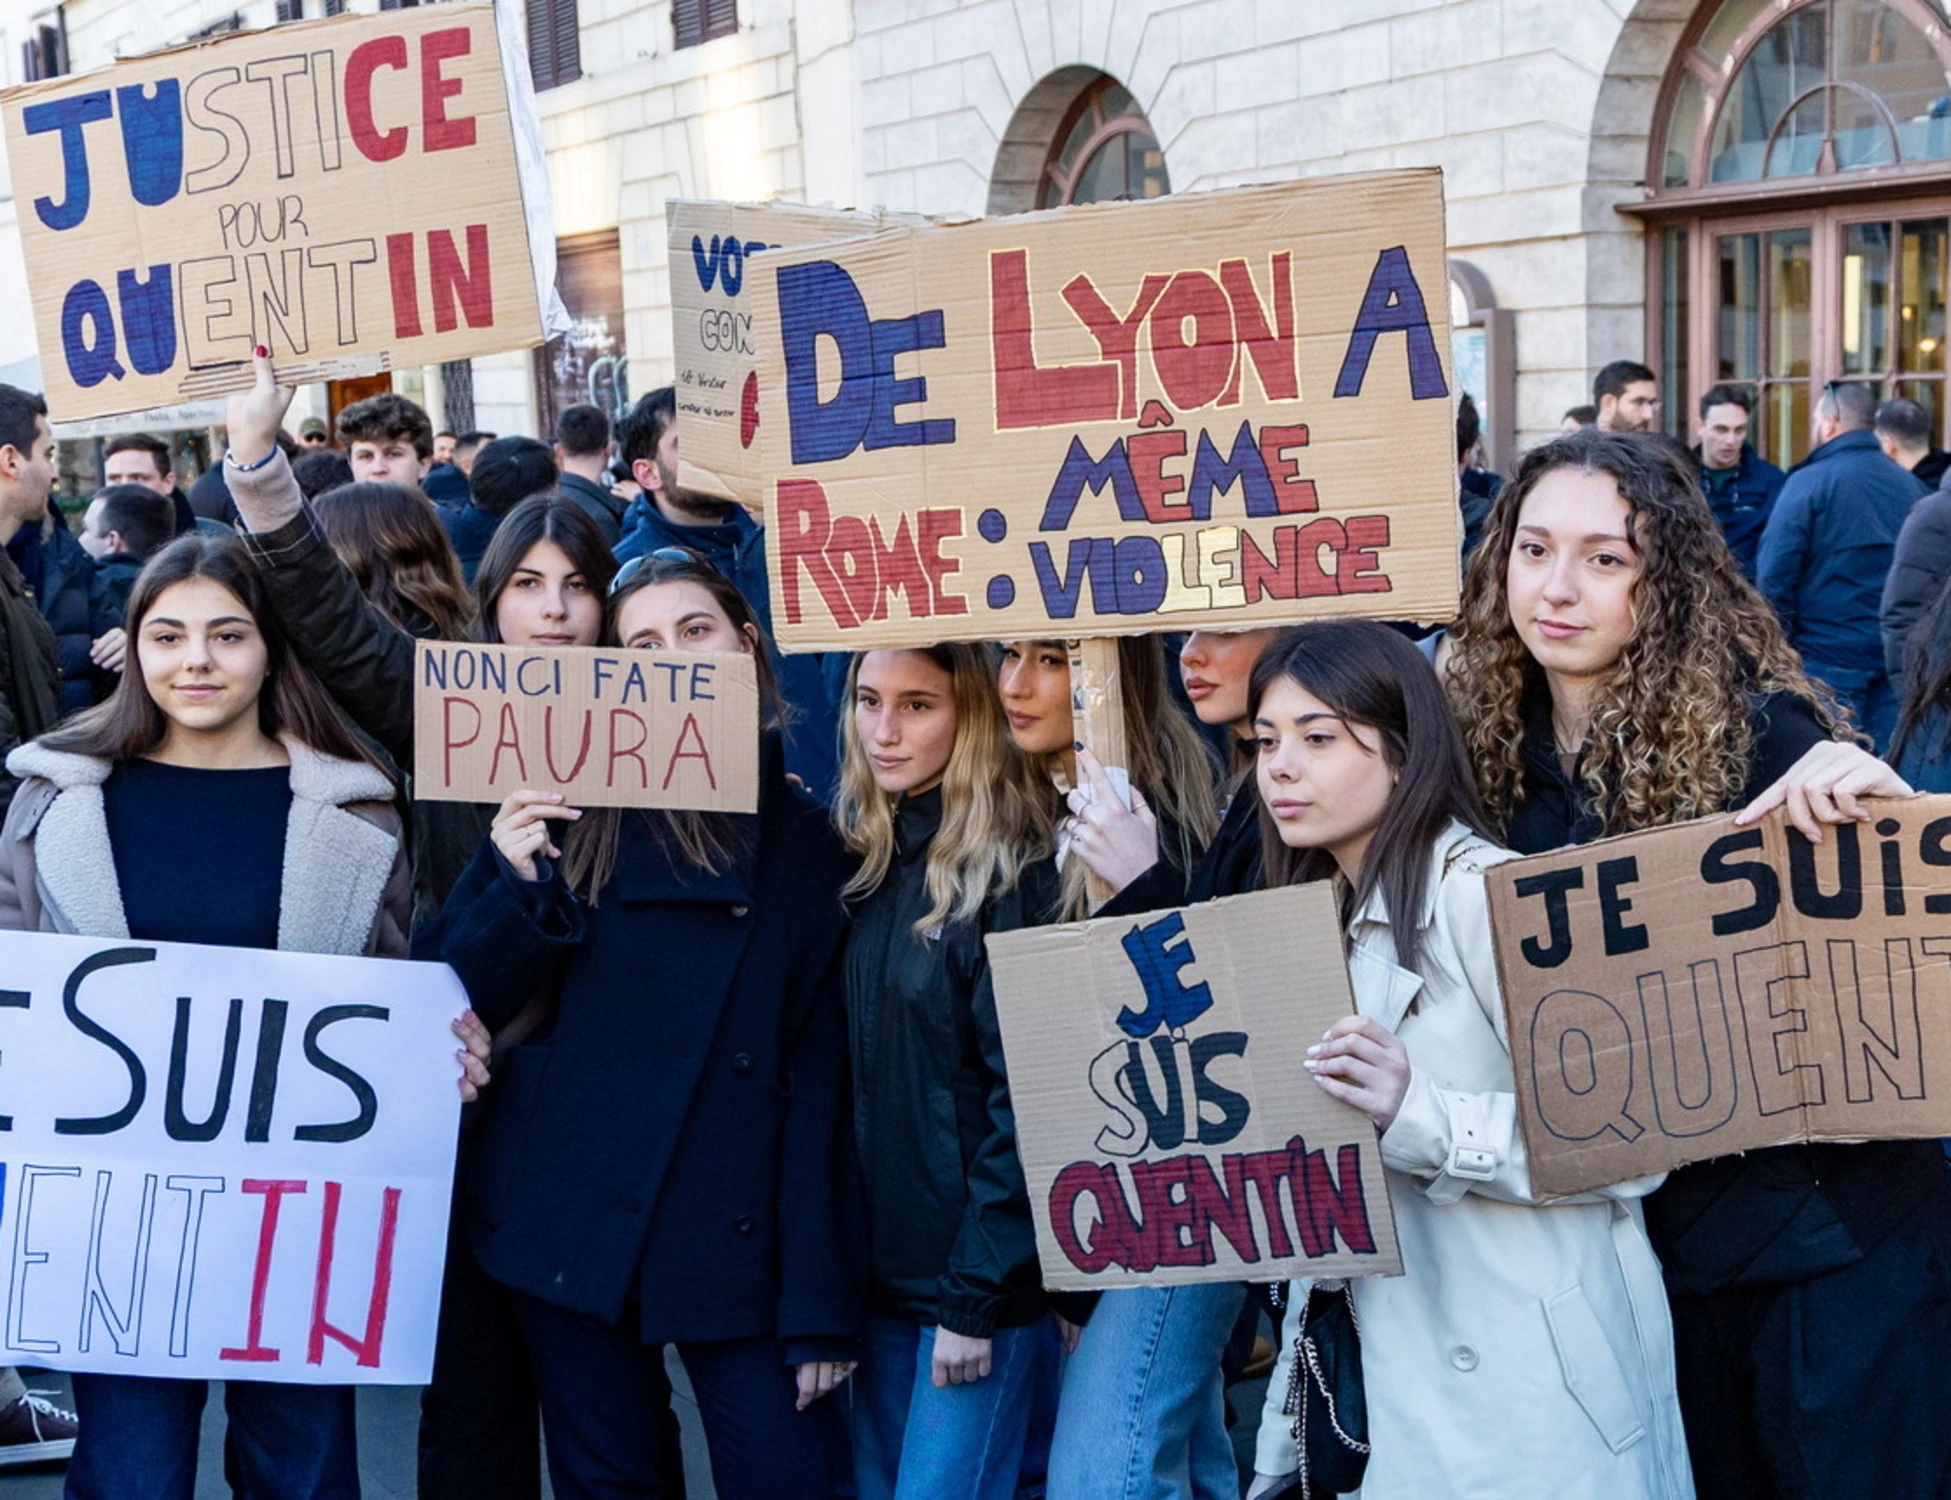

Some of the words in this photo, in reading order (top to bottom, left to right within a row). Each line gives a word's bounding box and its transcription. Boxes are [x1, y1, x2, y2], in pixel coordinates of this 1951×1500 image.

[22, 27, 478, 231] JUSTICE
[219, 195, 309, 250] POUR
[61, 224, 494, 388] QUENTIN
[776, 260, 956, 465] DE
[987, 248, 1303, 434] LYON
[1333, 245, 1449, 400] A
[1040, 400, 1319, 532] MÊME
[1028, 515, 1393, 620] VIOLENCE
[443, 696, 717, 791] PAURA
[593, 657, 717, 704] FATE
[1115, 911, 1215, 1038] JE
[1514, 855, 1650, 969] JE
[55, 947, 390, 1143] SUIS
[0, 1162, 402, 1368] ENTIN
